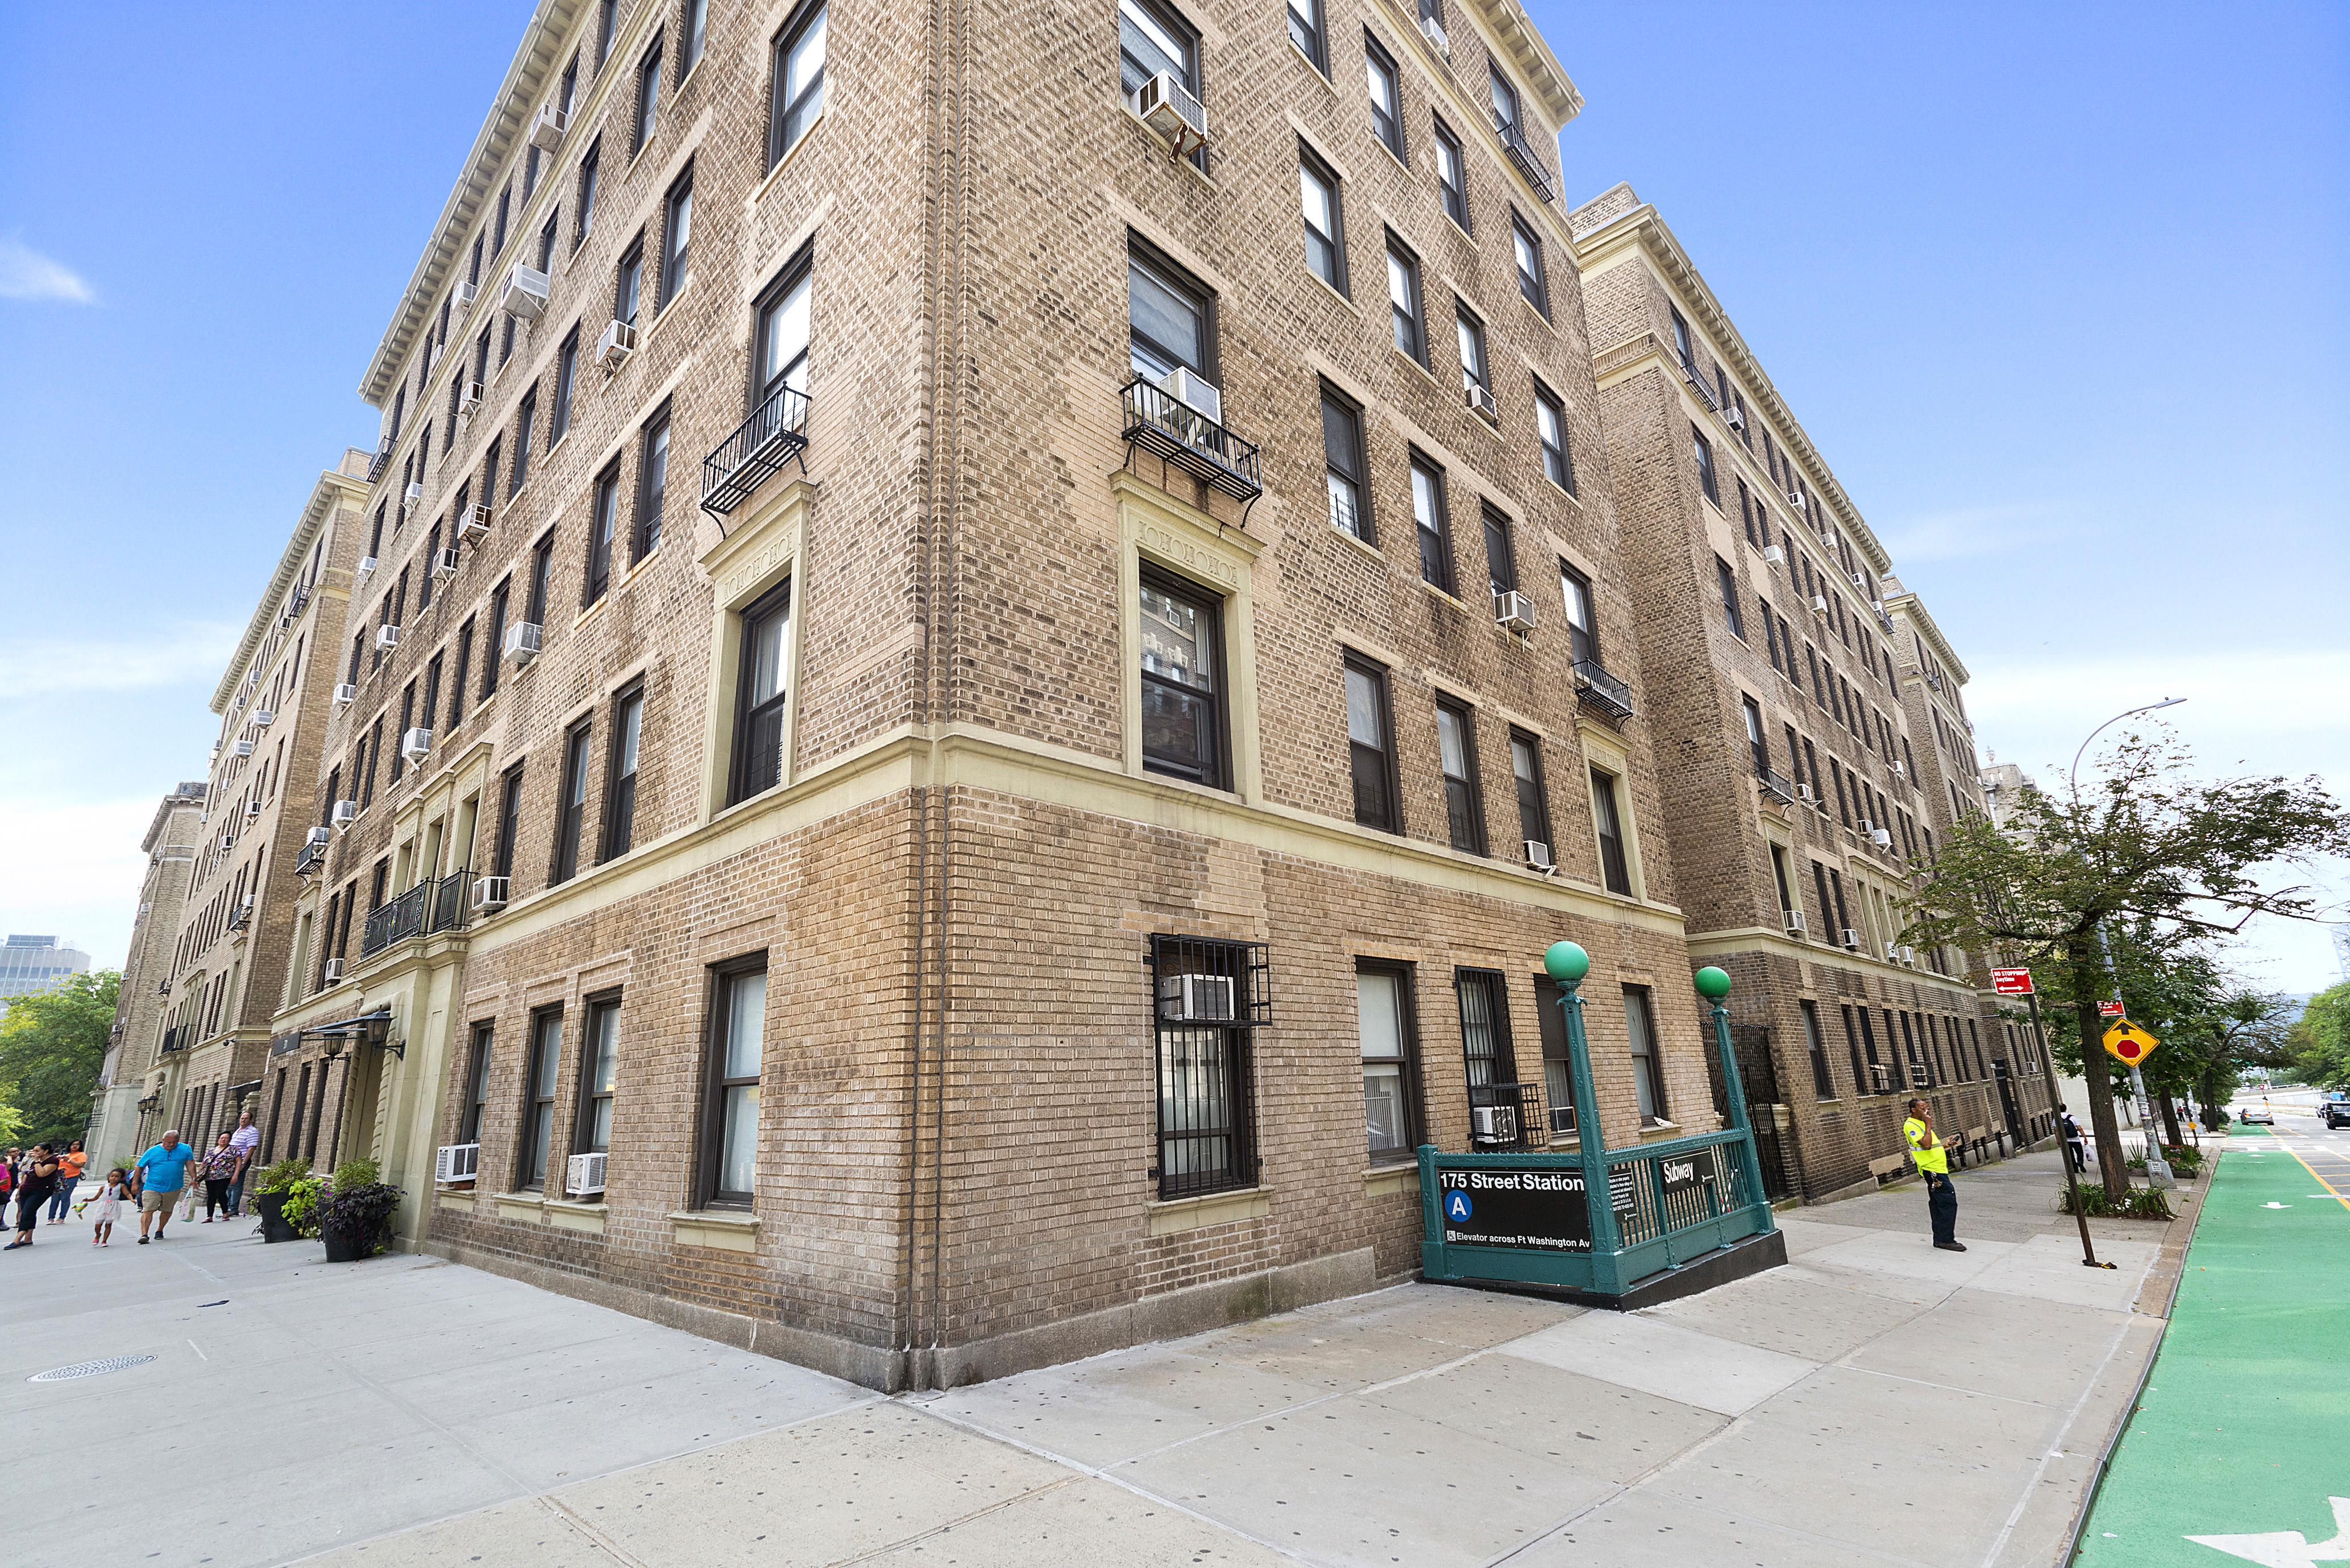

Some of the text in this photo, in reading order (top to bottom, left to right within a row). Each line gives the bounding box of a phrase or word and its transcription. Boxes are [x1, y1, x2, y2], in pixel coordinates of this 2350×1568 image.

[1663, 1161, 1693, 1184] Subway
[1440, 1173, 1585, 1191] 175 Street Station
[1452, 1197, 1467, 1216] A
[1456, 1232, 1488, 1242] Elevator
[1517, 1235, 1526, 1244] Ft
[1527, 1236, 1577, 1247] Washington
[1579, 1239, 1590, 1247] Av
